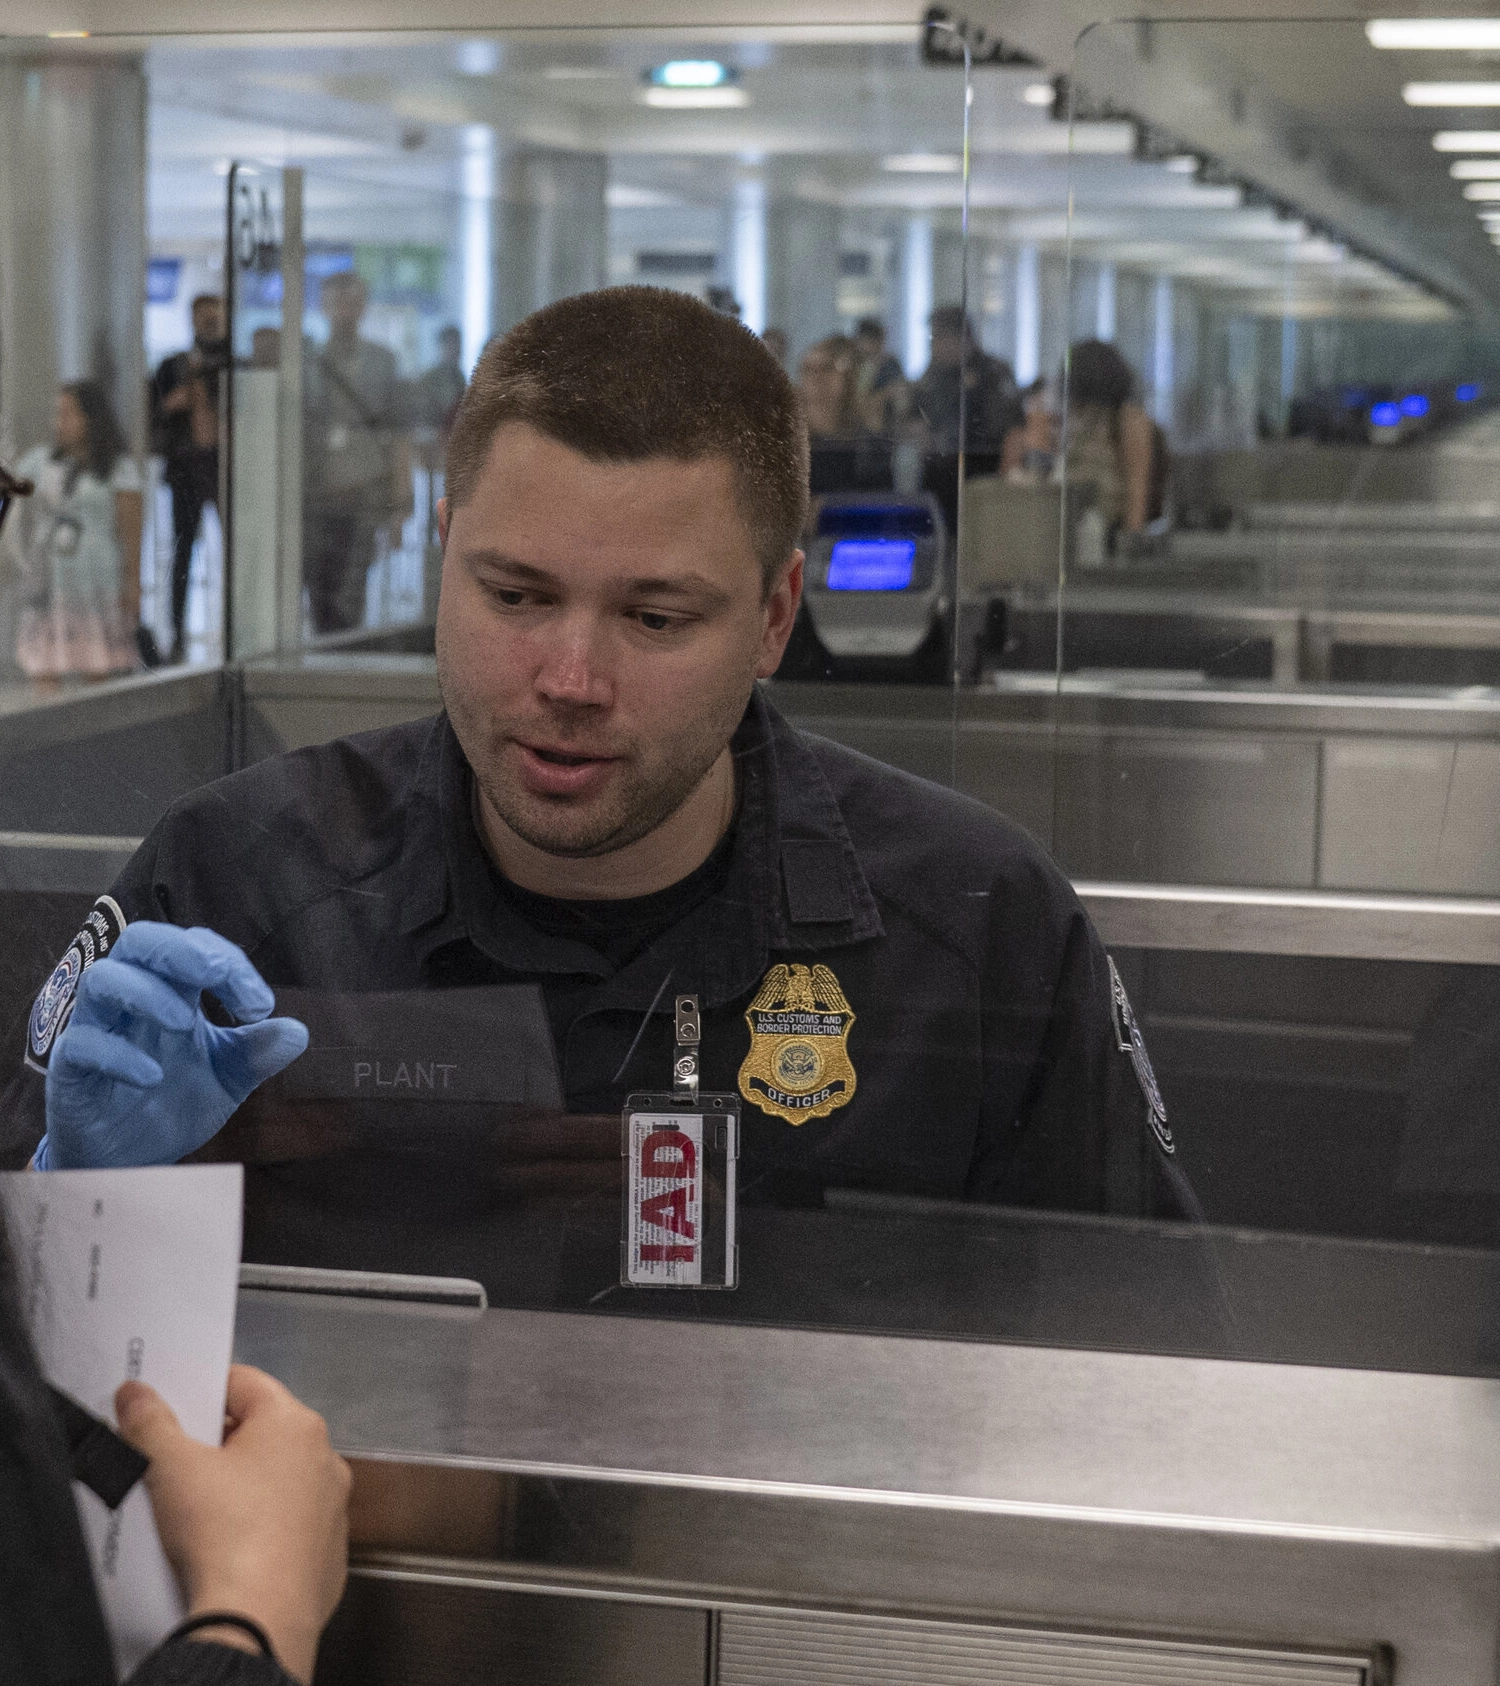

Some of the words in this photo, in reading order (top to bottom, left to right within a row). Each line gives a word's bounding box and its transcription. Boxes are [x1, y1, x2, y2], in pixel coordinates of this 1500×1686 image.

[756, 1023, 790, 1033] BORDER
[791, 1024, 842, 1035] PROTECTION
[758, 1013, 776, 1023] U.S.
[776, 1013, 820, 1024] CUSTOMS
[822, 1015, 842, 1025] AND
[355, 1061, 458, 1089] PLANT
[767, 1087, 831, 1108] OFFICER
[640, 1130, 696, 1263] IAD
